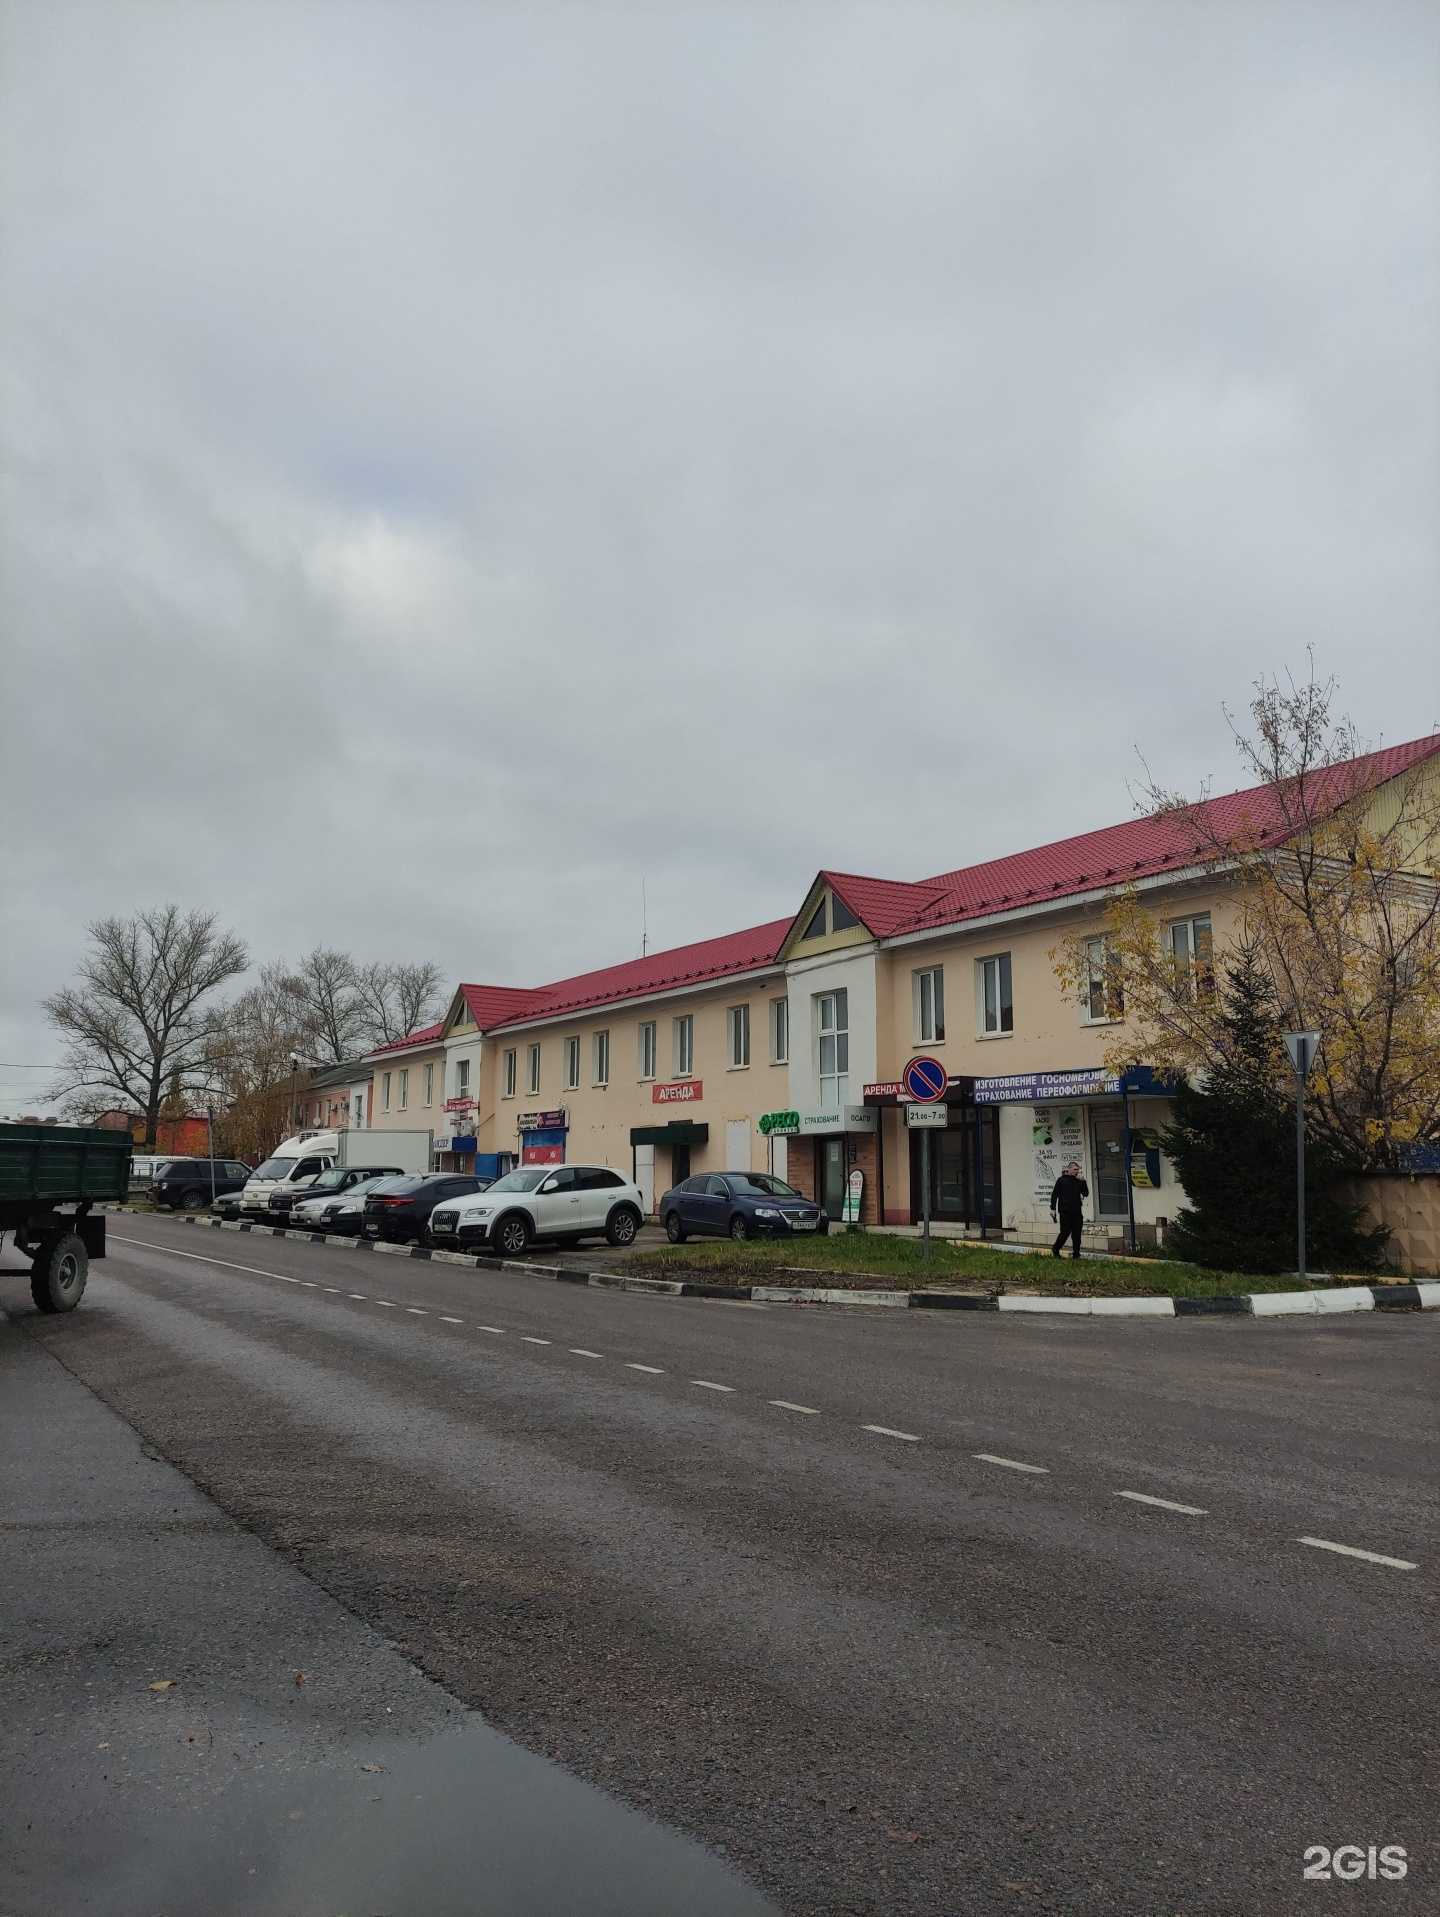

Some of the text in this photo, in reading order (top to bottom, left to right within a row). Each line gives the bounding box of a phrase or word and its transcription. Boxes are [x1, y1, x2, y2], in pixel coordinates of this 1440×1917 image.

[975, 1075, 1037, 1090] ИЗГОТОВЛЕНИЕ
[659, 1086, 695, 1100] АРЕНДА
[864, 1084, 898, 1096] АРЕНДА
[975, 1088, 1033, 1102] СТРАХОВАНИЕ
